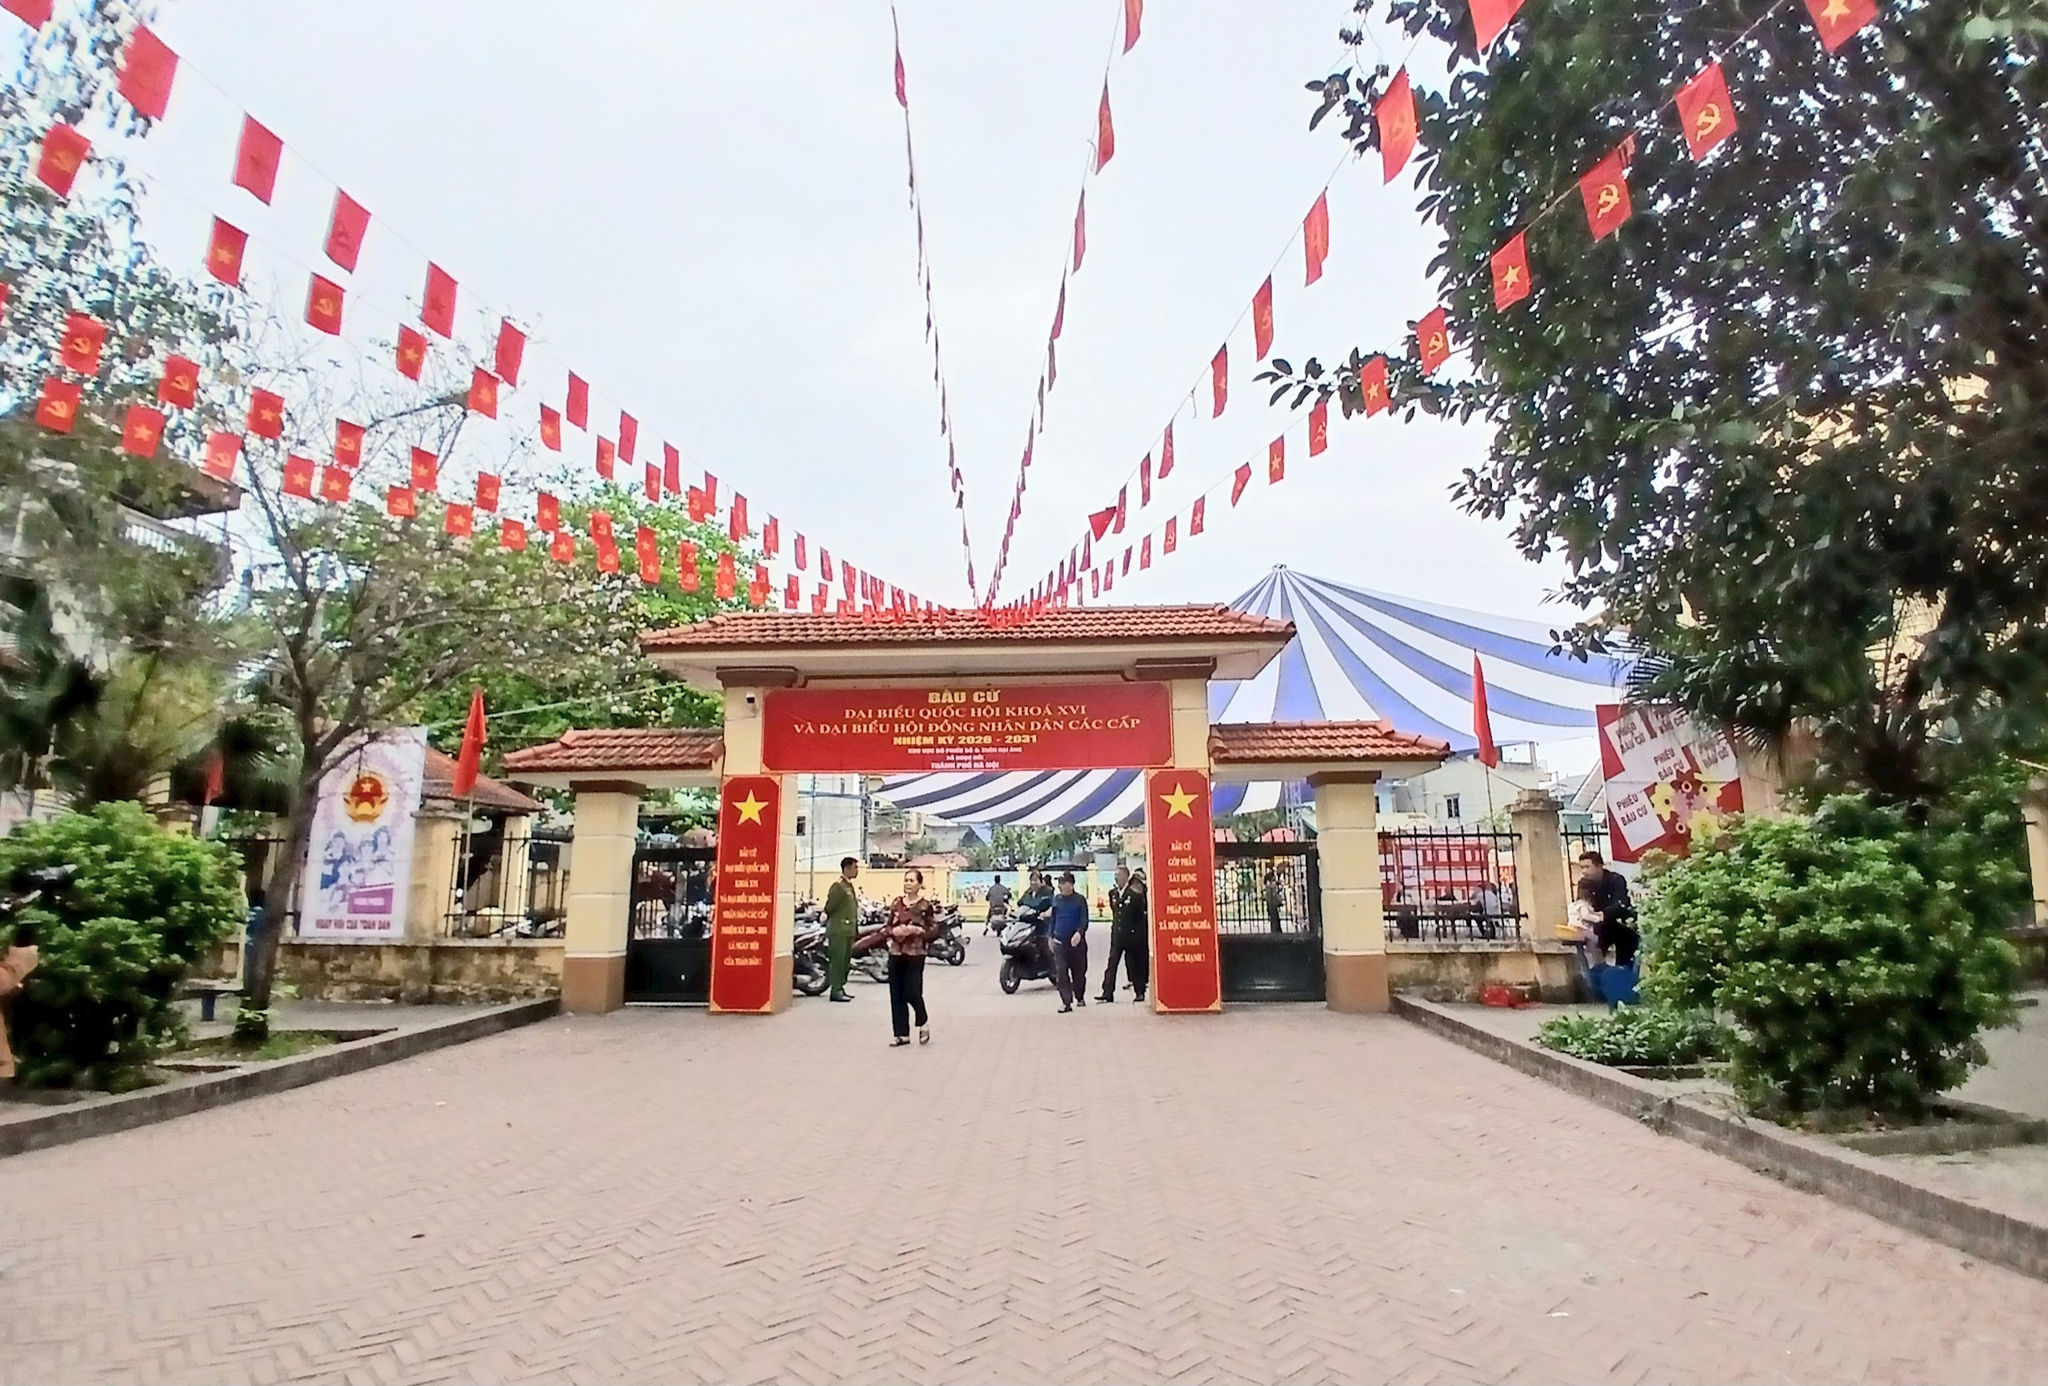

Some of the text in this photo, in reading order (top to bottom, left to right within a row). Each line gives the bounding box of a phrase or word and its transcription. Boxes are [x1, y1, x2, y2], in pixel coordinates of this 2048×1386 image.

[877, 704, 915, 719] BIỂU
[919, 704, 966, 719] QUỐC
[970, 705, 1000, 718] HỘI
[1005, 704, 1052, 717] KHOÁ
[1057, 705, 1086, 715] XVI
[794, 724, 815, 734] VÀ
[852, 719, 890, 734] BIỂU
[894, 721, 924, 735] HỘI
[928, 719, 975, 733] ĐỒNG
[979, 719, 1026, 732] NHÂN
[1030, 719, 1064, 731] DÂN
[1068, 718, 1103, 731] CÁC
[1107, 714, 1142, 729] CẤP
[893, 735, 934, 746] NHIỆM
[938, 734, 954, 745] KỲ
[1004, 733, 1037, 744] 2031
